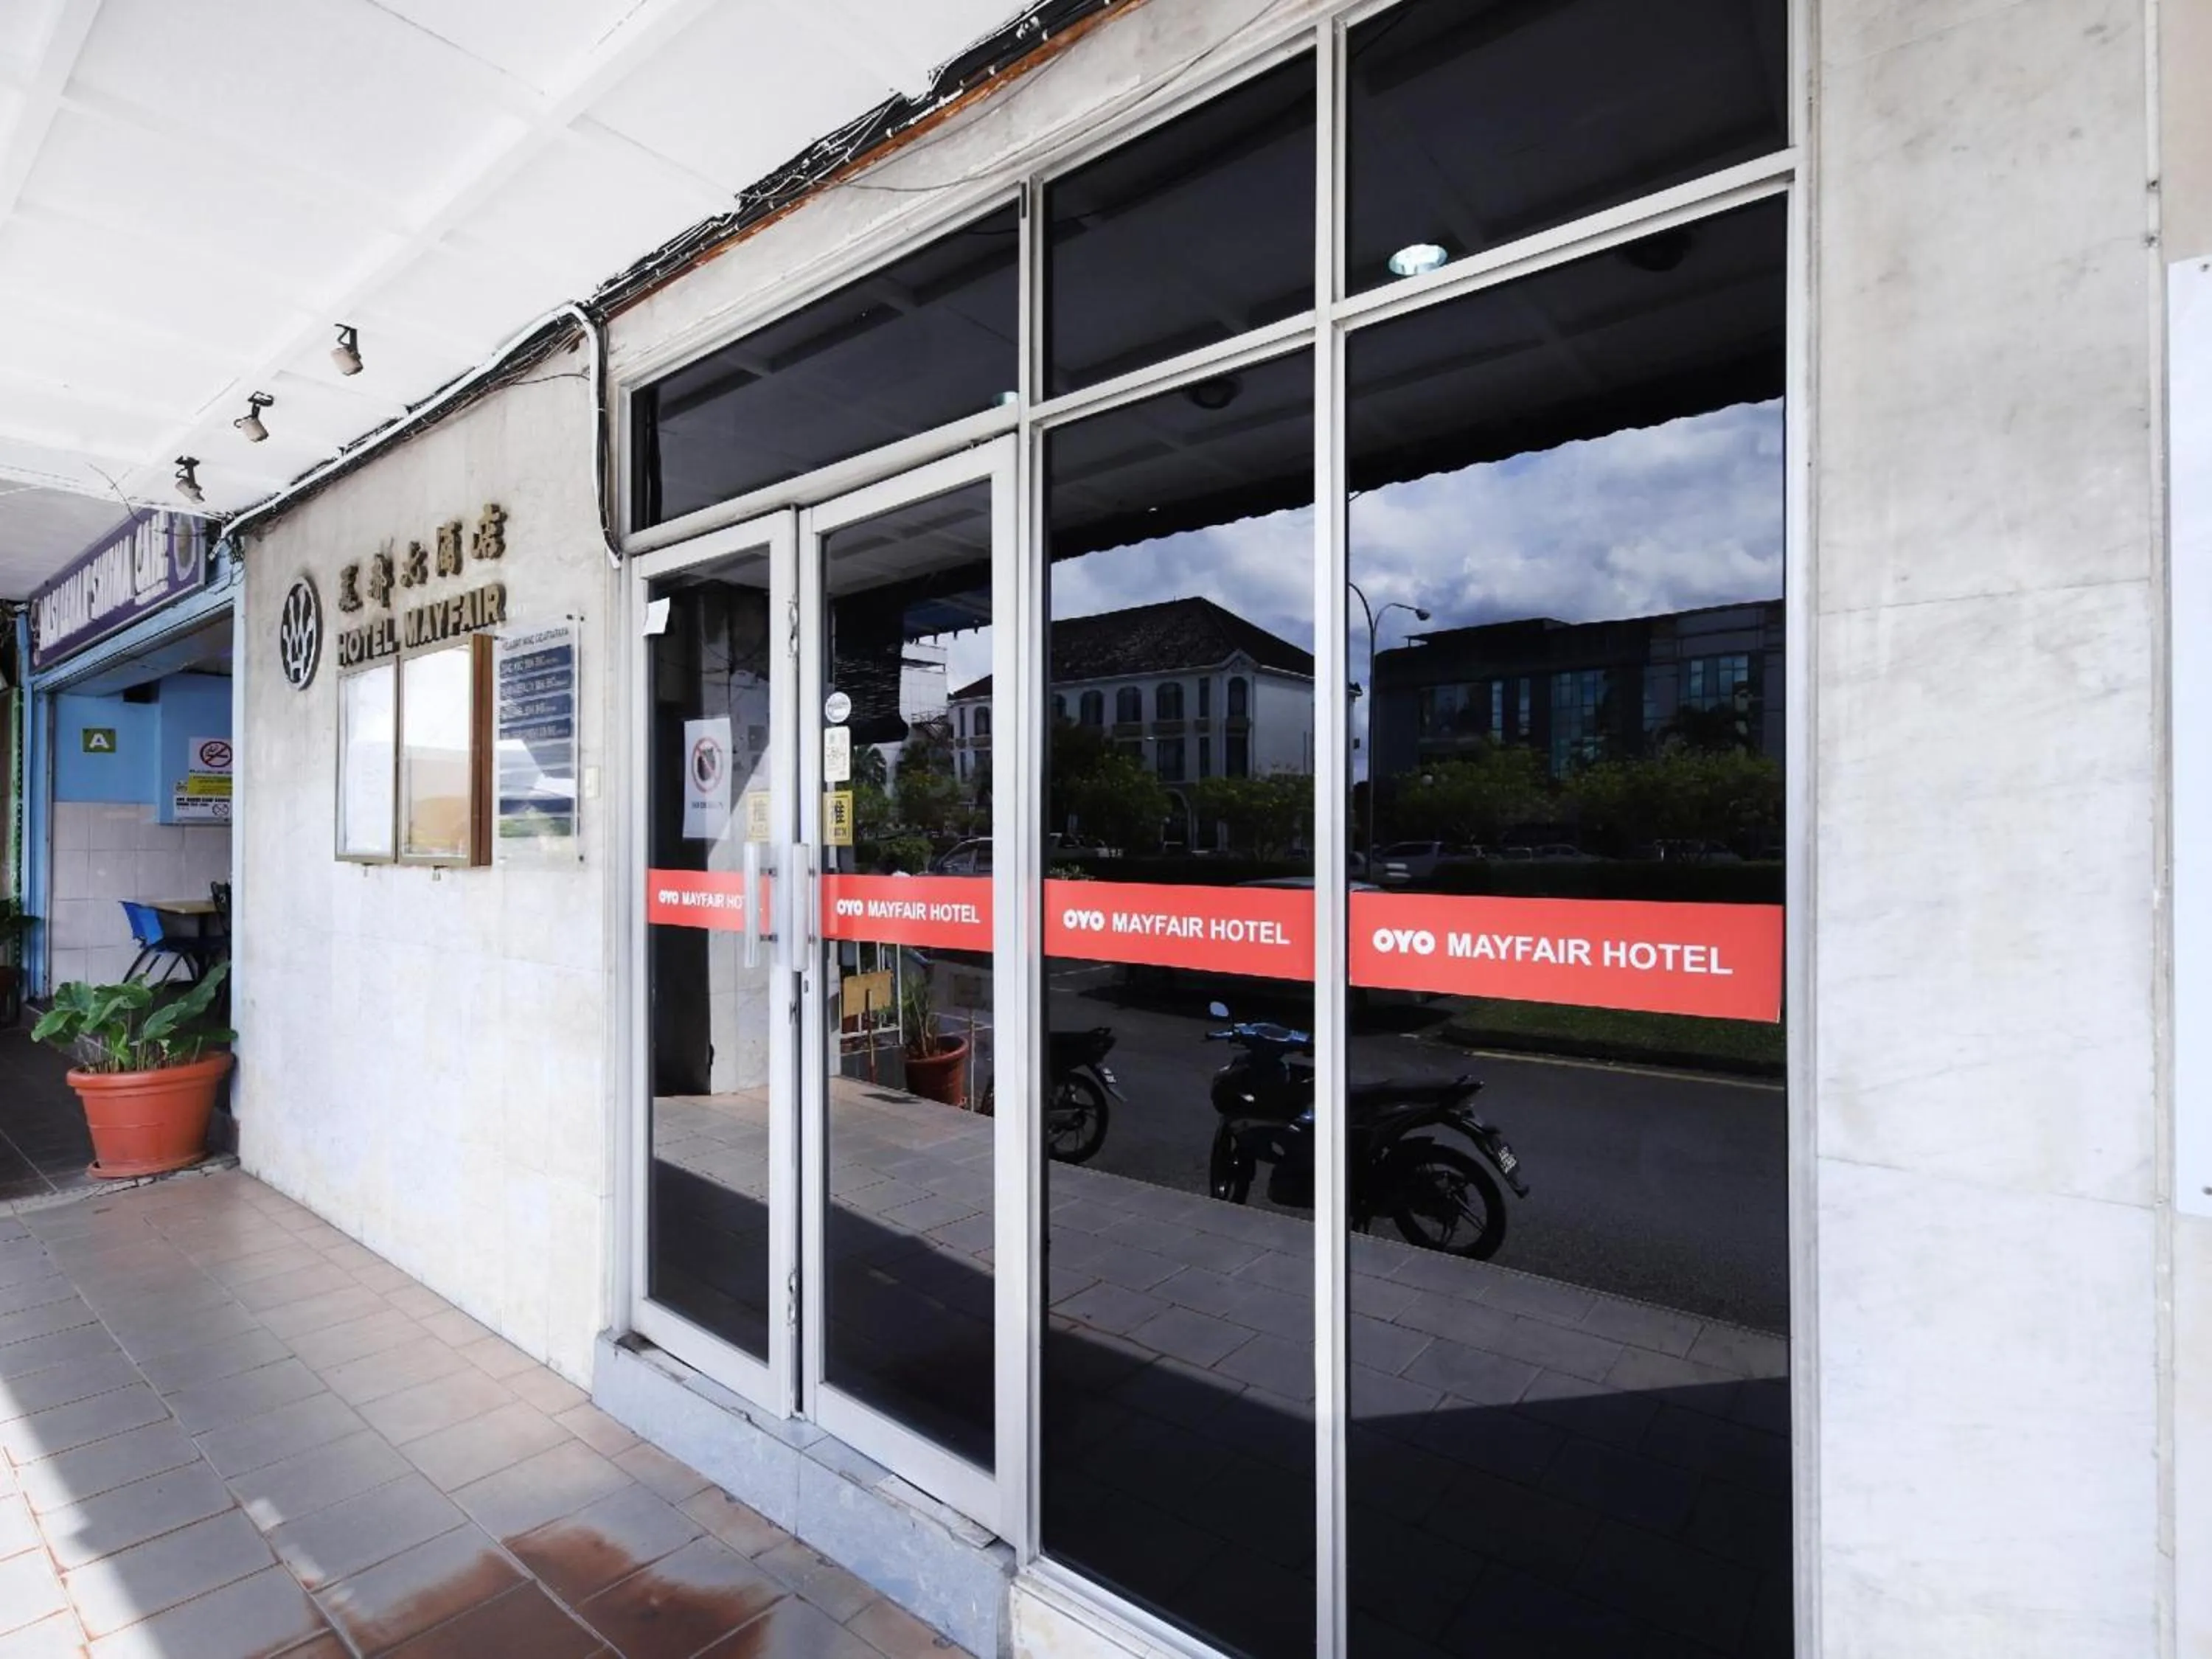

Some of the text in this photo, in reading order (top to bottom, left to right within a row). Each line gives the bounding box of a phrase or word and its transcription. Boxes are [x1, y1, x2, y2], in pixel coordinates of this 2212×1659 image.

[337, 582, 507, 668] HOTEL MAYFAIR
[89, 732, 110, 749] A
[658, 890, 679, 905] OYO
[682, 891, 725, 907] MAYFAIR
[837, 898, 981, 924] OYO MAYFAIR HOTEL
[1063, 908, 1291, 946] OYO MAYFAIR HOTEL
[1372, 926, 1733, 975] OYO MAYFAIR HOTEL
